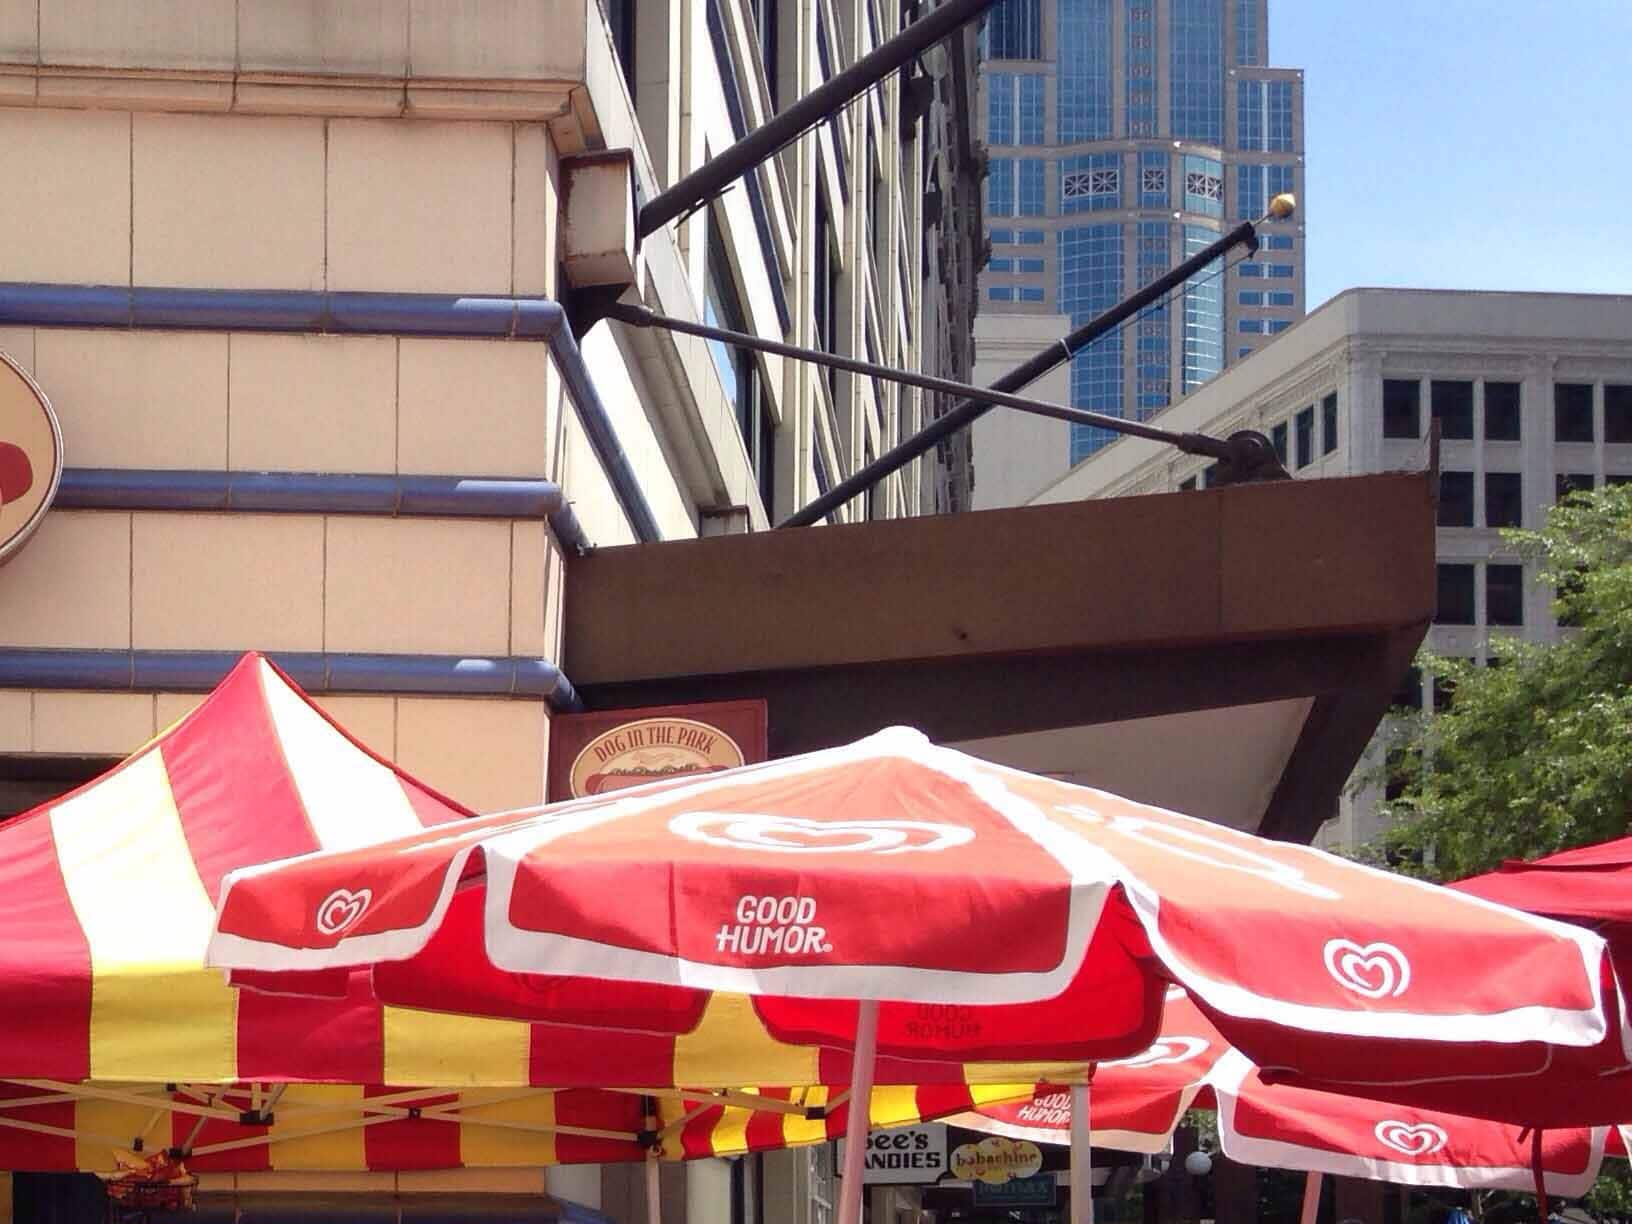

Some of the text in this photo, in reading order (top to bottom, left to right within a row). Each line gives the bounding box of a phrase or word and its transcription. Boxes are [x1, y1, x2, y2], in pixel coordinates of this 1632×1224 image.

[592, 725, 719, 763] DOG IN THE PARK
[735, 895, 817, 925] GOOD
[863, 1151, 941, 1169] ANDIES
